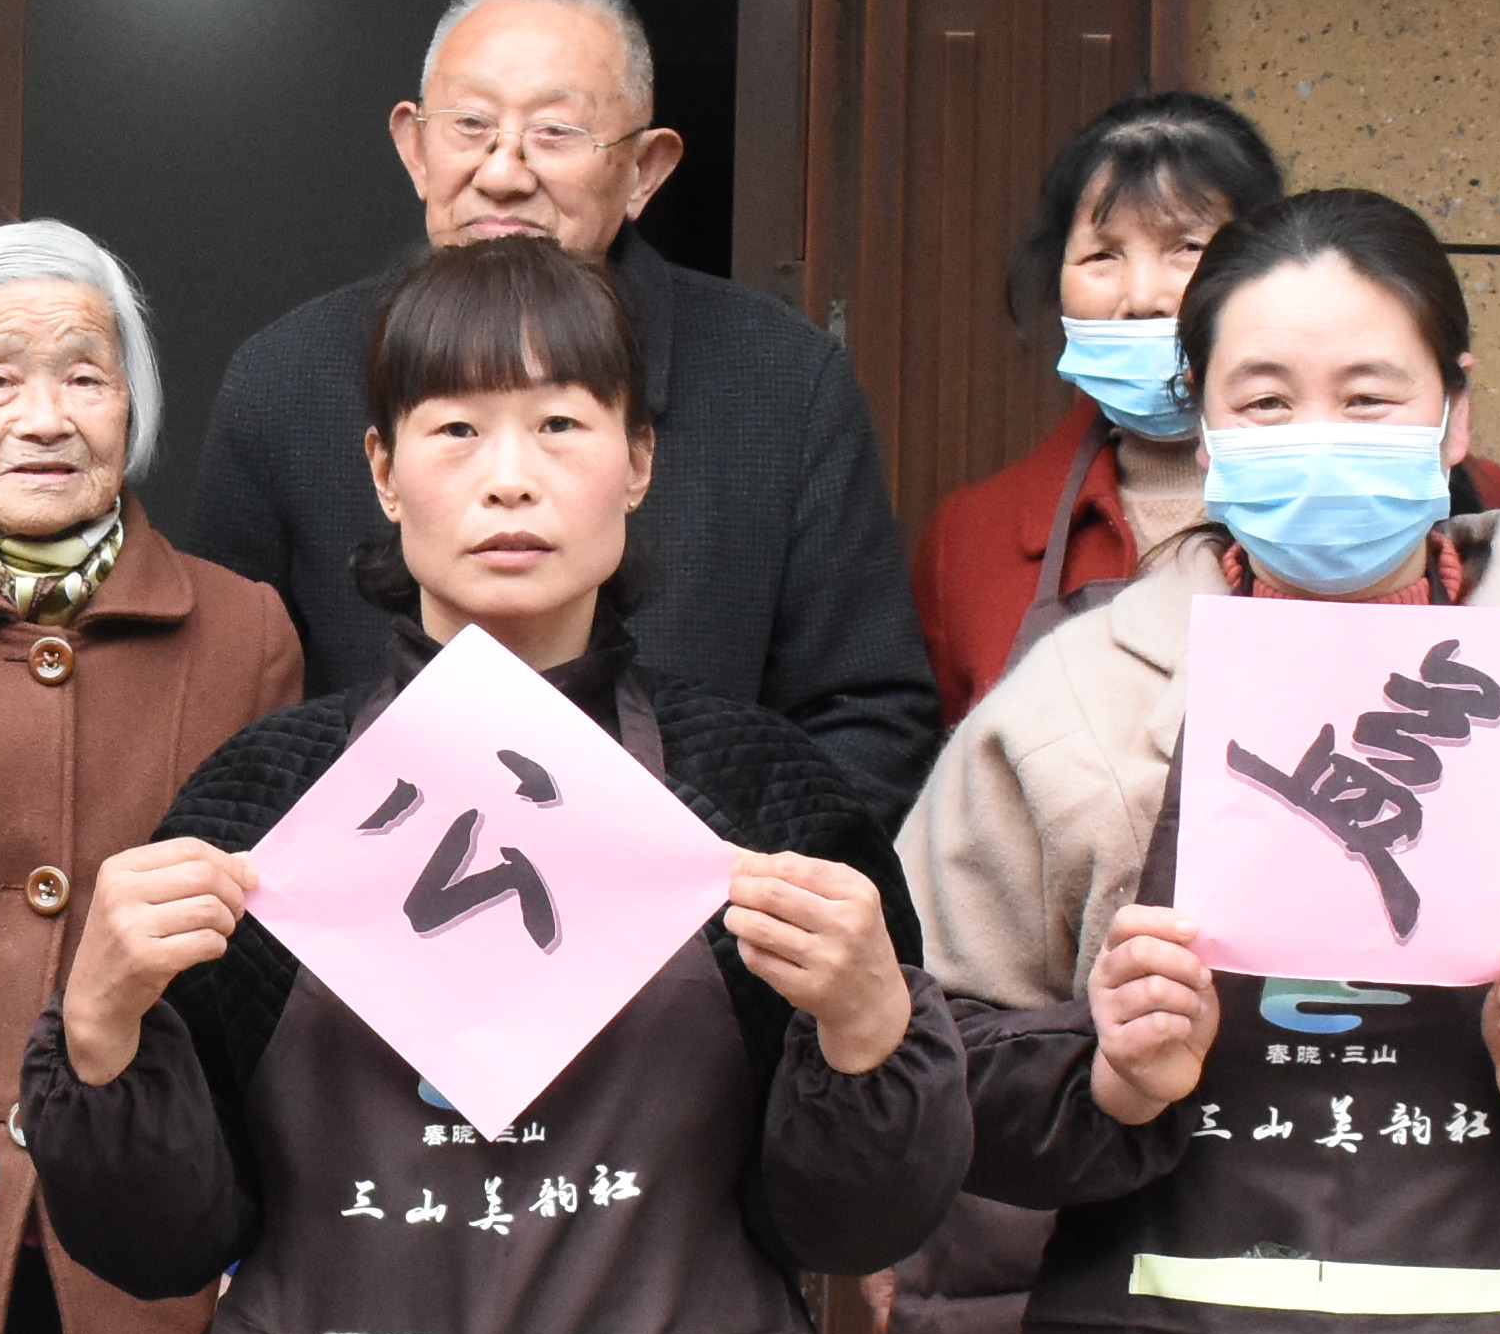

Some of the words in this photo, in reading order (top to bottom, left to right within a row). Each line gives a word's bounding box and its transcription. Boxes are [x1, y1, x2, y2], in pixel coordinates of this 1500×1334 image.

[356, 748, 563, 956] 公
[1191, 1095, 1492, 1153] 三山美韵社
[340, 1164, 642, 1235] 三山美韵社
